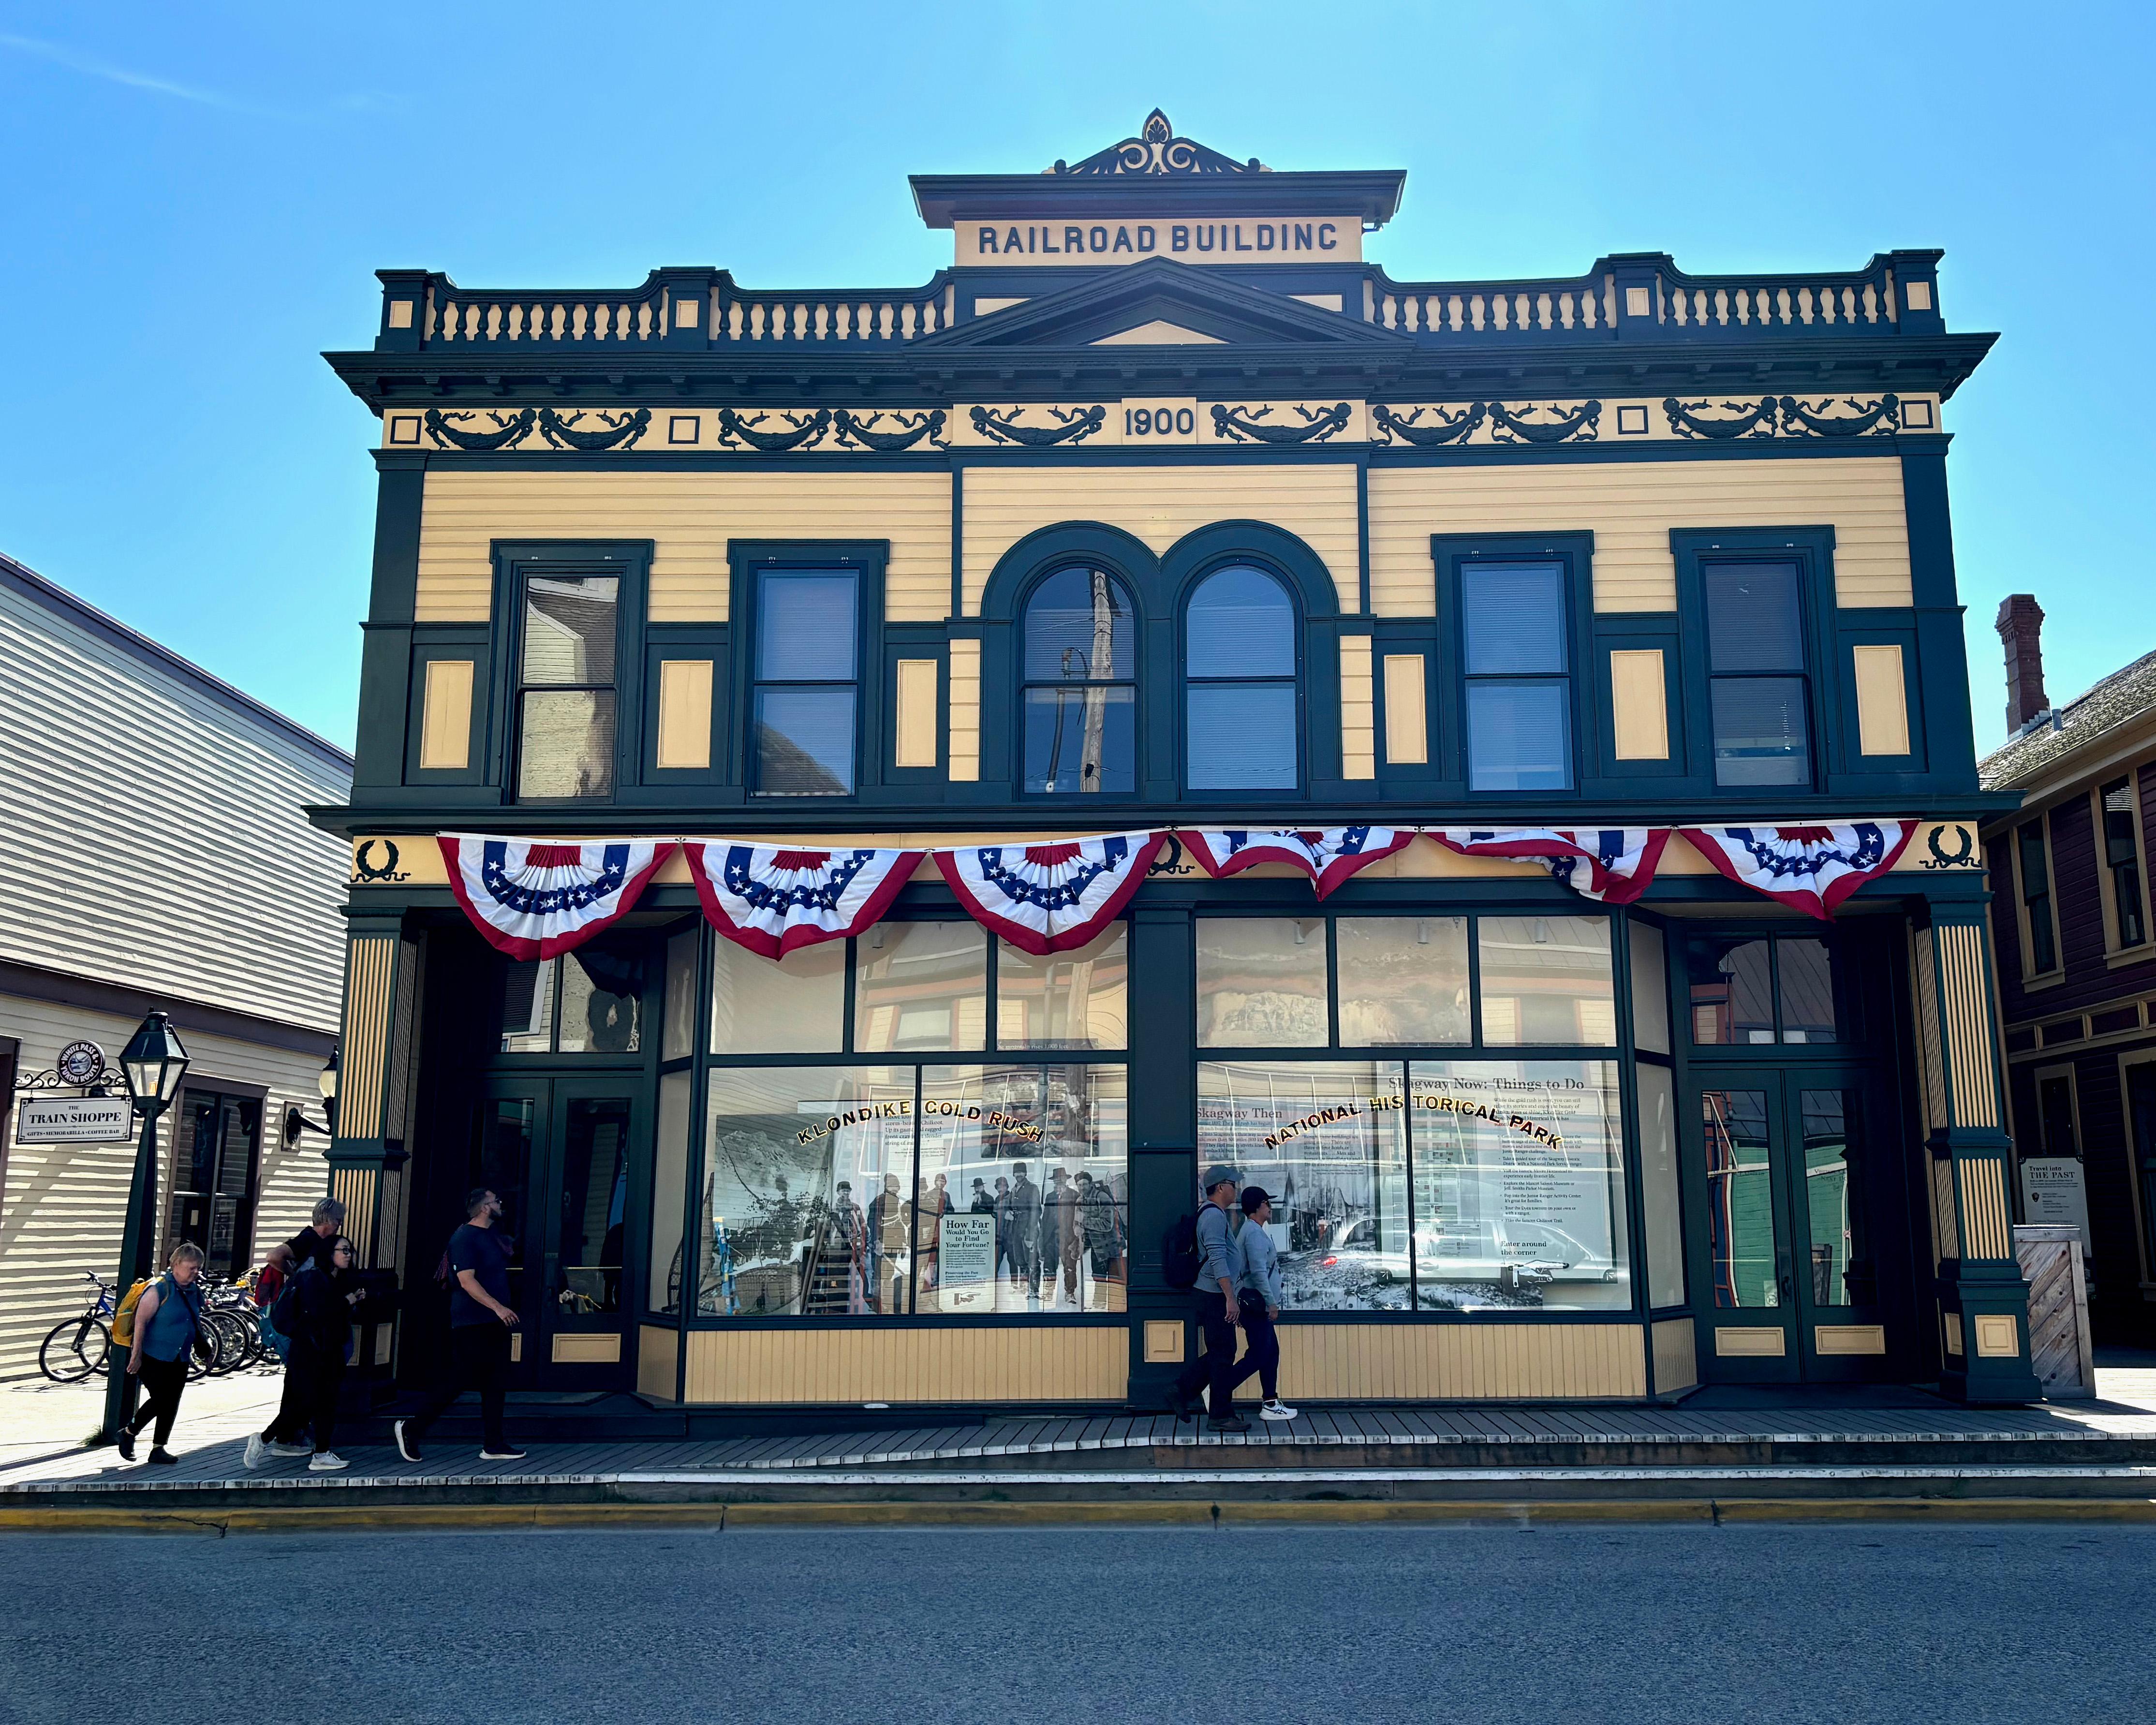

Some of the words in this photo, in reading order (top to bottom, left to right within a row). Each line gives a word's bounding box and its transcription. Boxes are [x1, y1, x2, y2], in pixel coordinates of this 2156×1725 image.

[979, 226, 1155, 253] RAILROAD
[1125, 408, 1194, 435] 1900
[61, 1044, 79, 1061] WHITE
[80, 1044, 96, 1054] PASS
[60, 1065, 79, 1083] YUKON
[80, 1064, 99, 1082] ROUTE
[1454, 1078, 1487, 1089] Now:
[1493, 1078, 1541, 1091] Things
[1546, 1079, 1560, 1090] to
[1565, 1078, 1584, 1090] Do
[29, 1114, 68, 1123] TRAIN
[70, 1112, 121, 1122] SHOPPE
[1252, 1108, 1282, 1118] Then
[797, 1100, 912, 1145] KLONDIKE
[925, 1101, 981, 1121] GOLD
[988, 1111, 1045, 1144] RUSH
[1263, 1102, 1362, 1150] NATIONAL
[1509, 1114, 1565, 1151] PARK
[946, 1220, 968, 1228] How
[972, 1220, 989, 1228] Far
